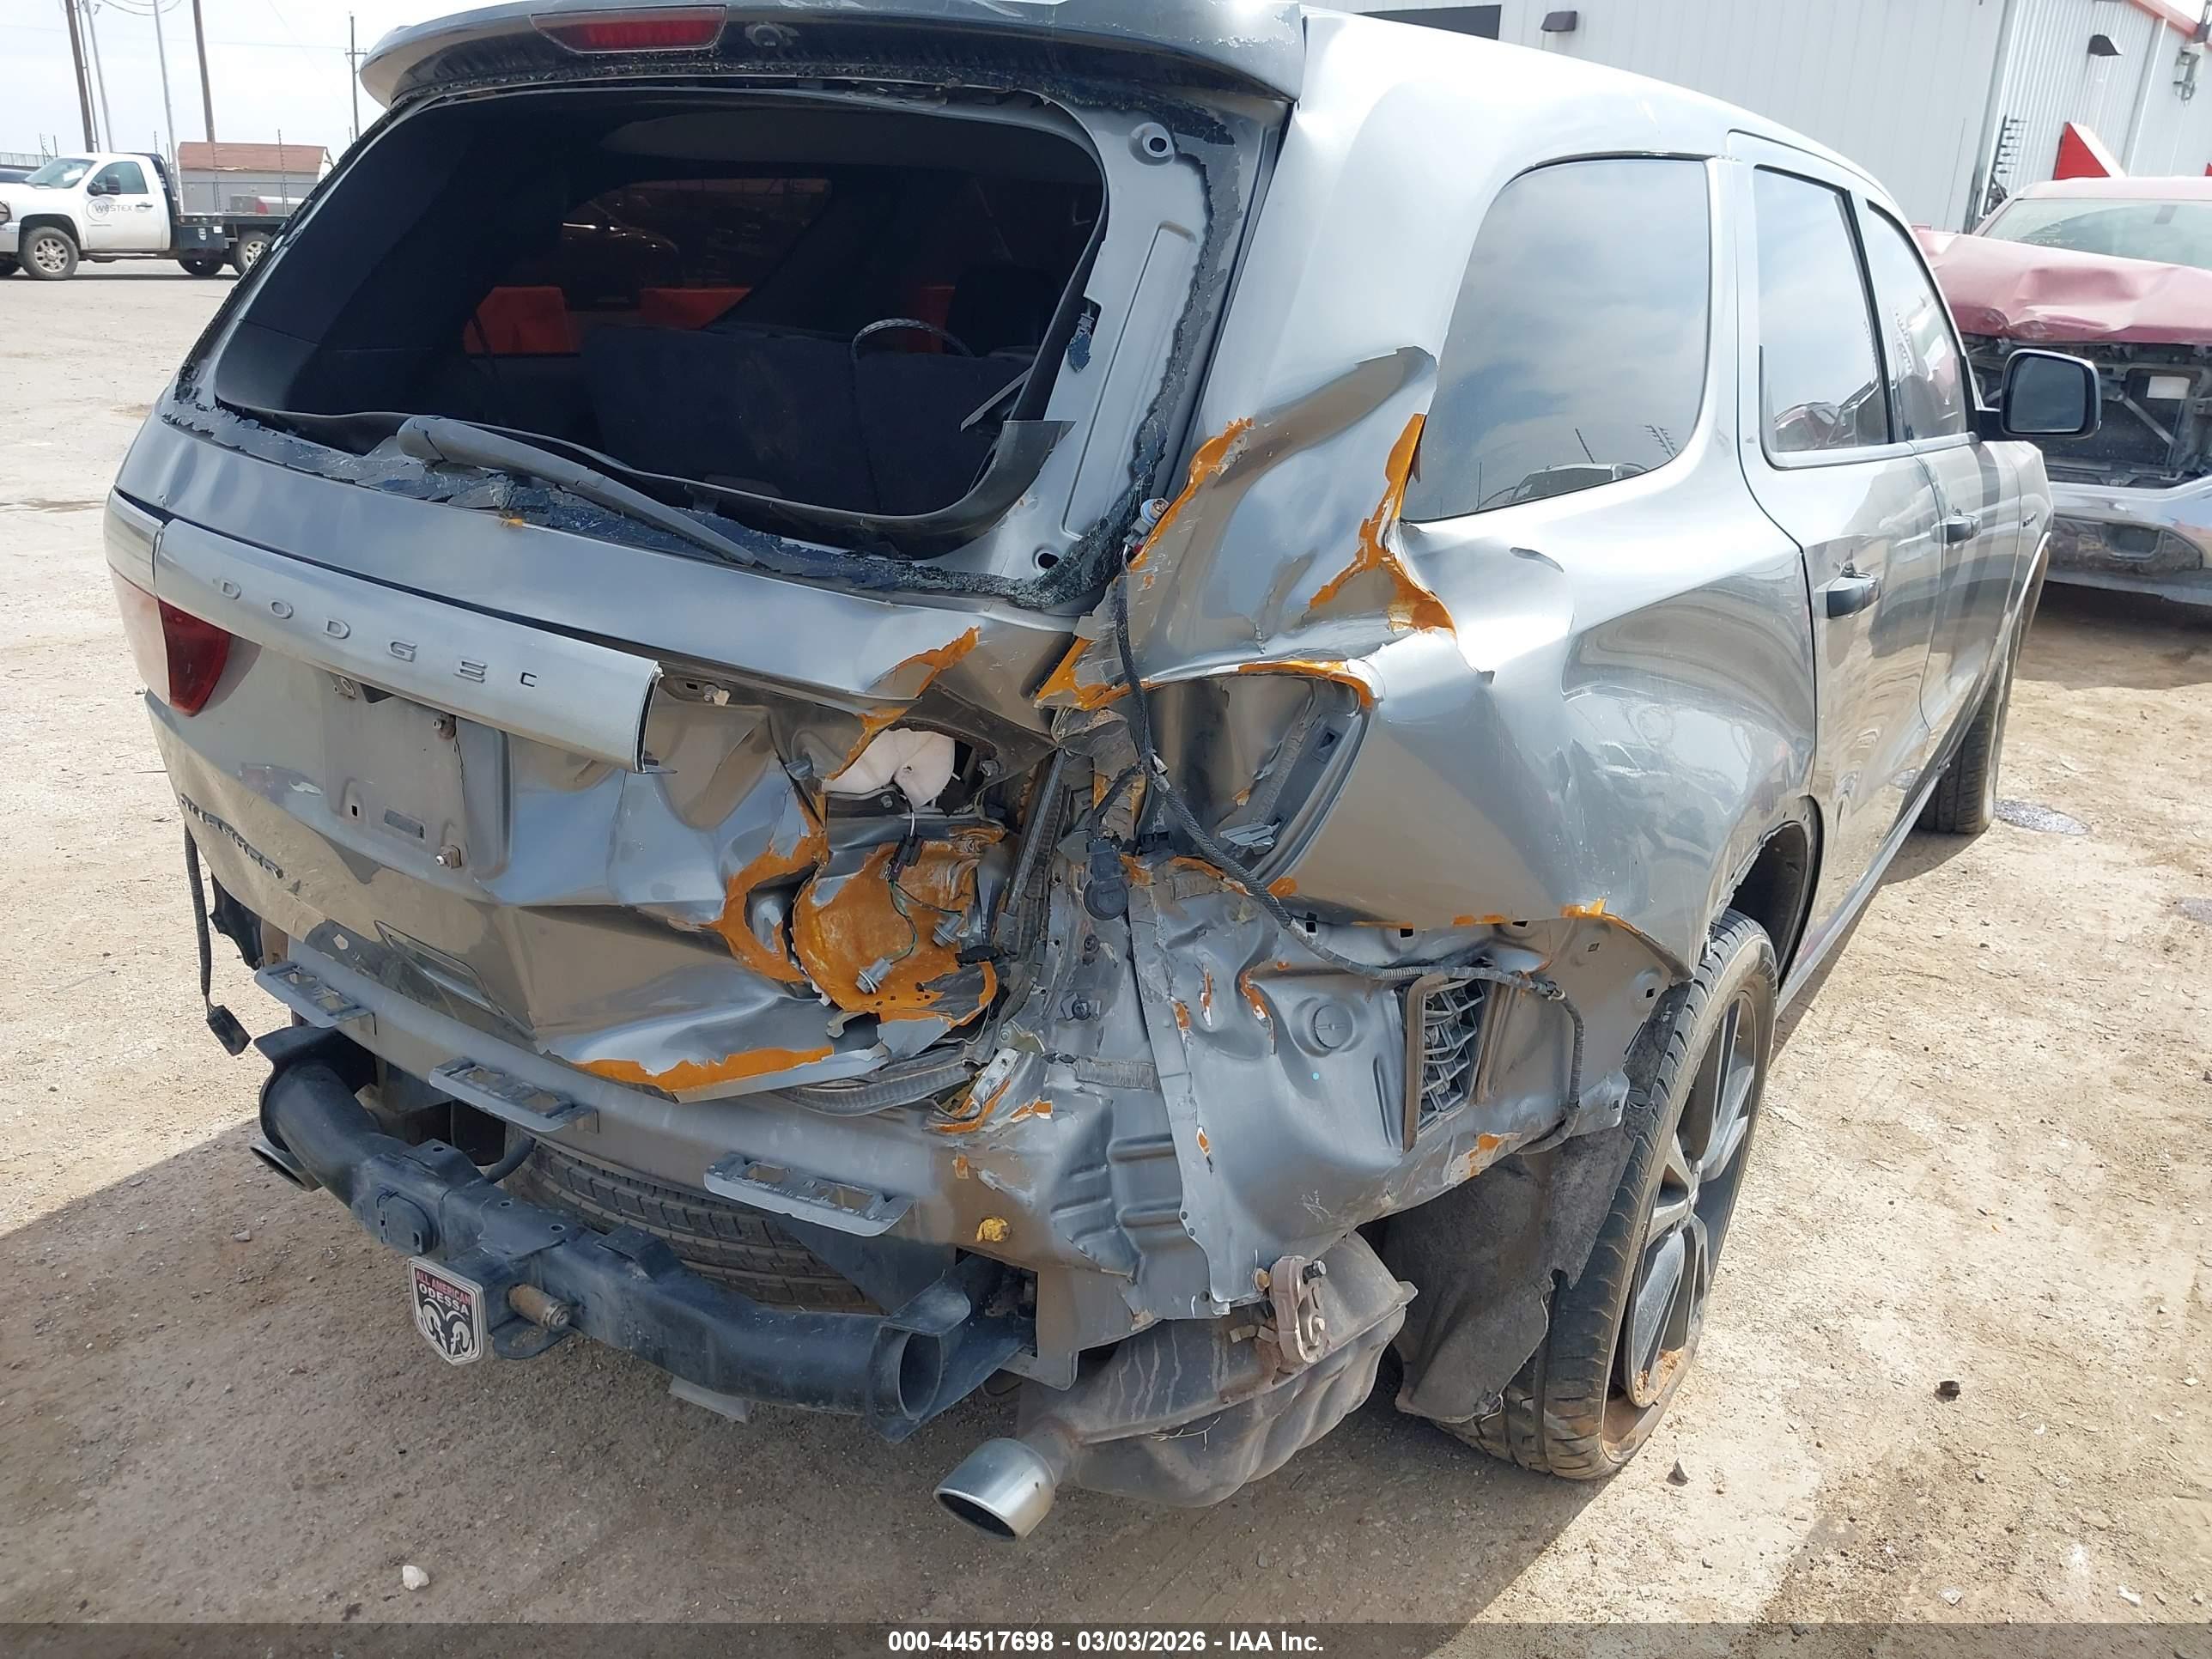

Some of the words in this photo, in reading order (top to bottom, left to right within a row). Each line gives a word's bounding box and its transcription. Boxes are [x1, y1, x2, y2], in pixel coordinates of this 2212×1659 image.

[220, 579, 489, 684] DODGE
[416, 1270, 431, 1285] ALL
[431, 1278, 471, 1306] AMERICAN
[418, 1283, 470, 1316] ODESSA
